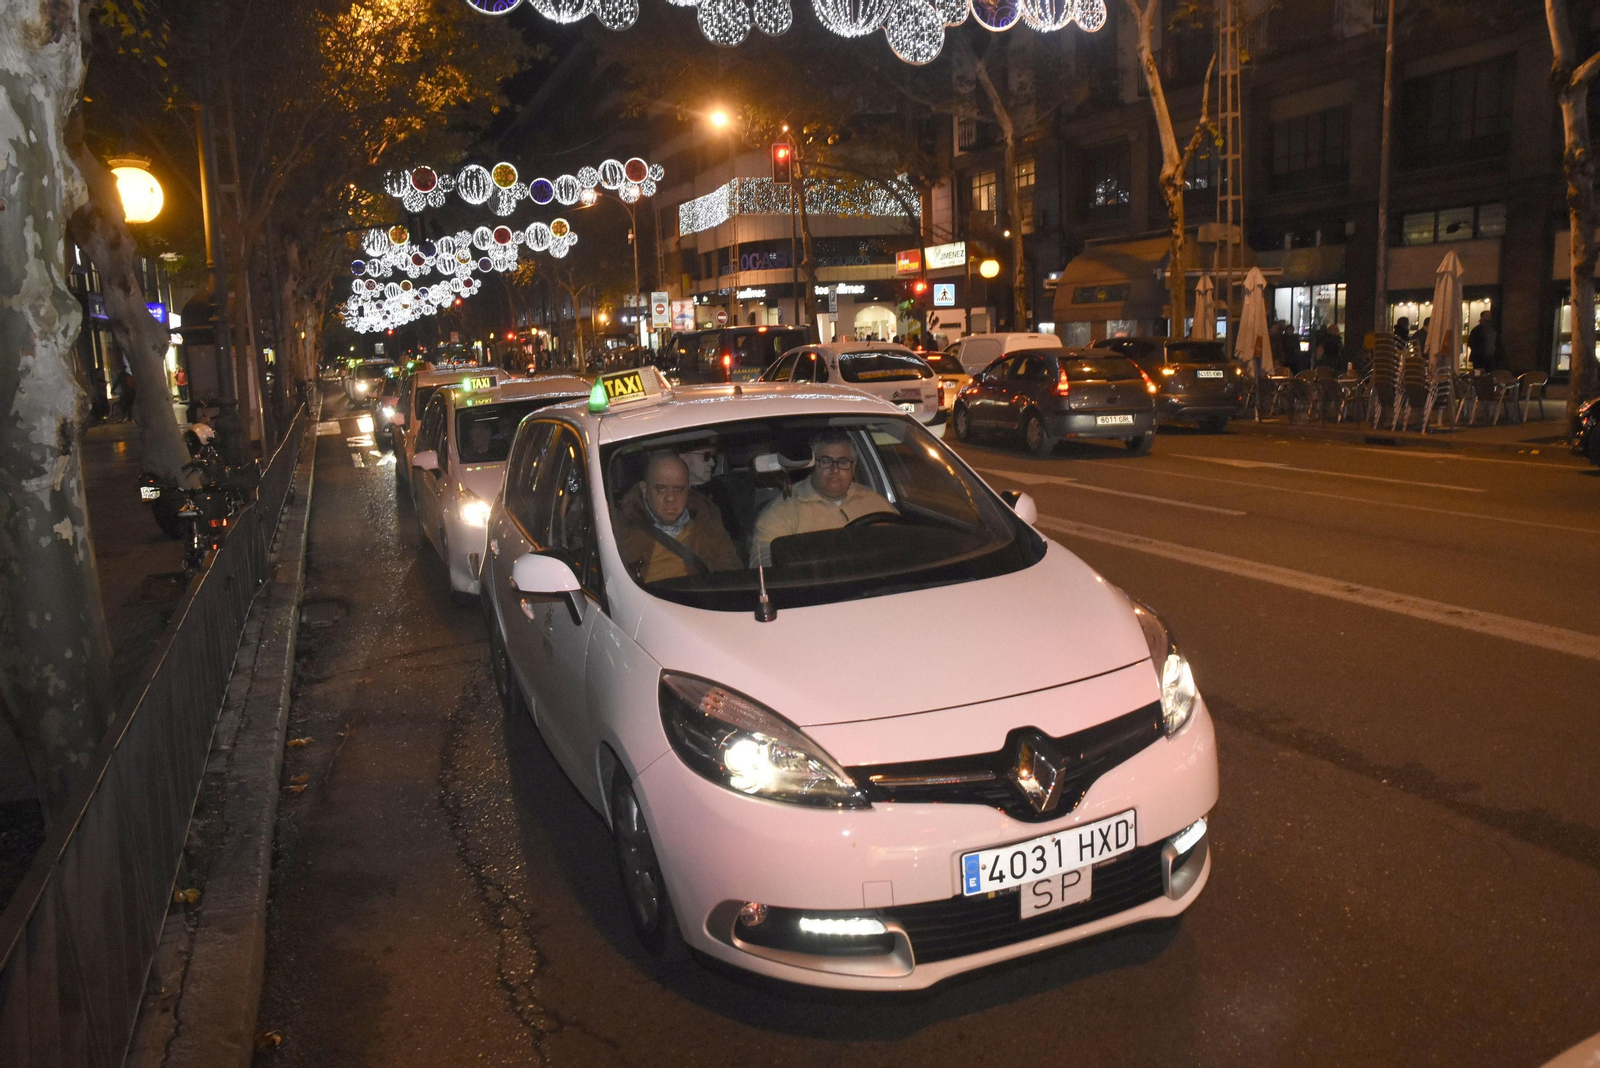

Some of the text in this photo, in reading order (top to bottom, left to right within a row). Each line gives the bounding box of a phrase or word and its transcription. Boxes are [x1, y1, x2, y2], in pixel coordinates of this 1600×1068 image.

[470, 377, 491, 389] TAXI
[604, 375, 644, 397] TAXI
[969, 818, 1129, 888] E 4031 HXD
[1032, 869, 1082, 909] SP
